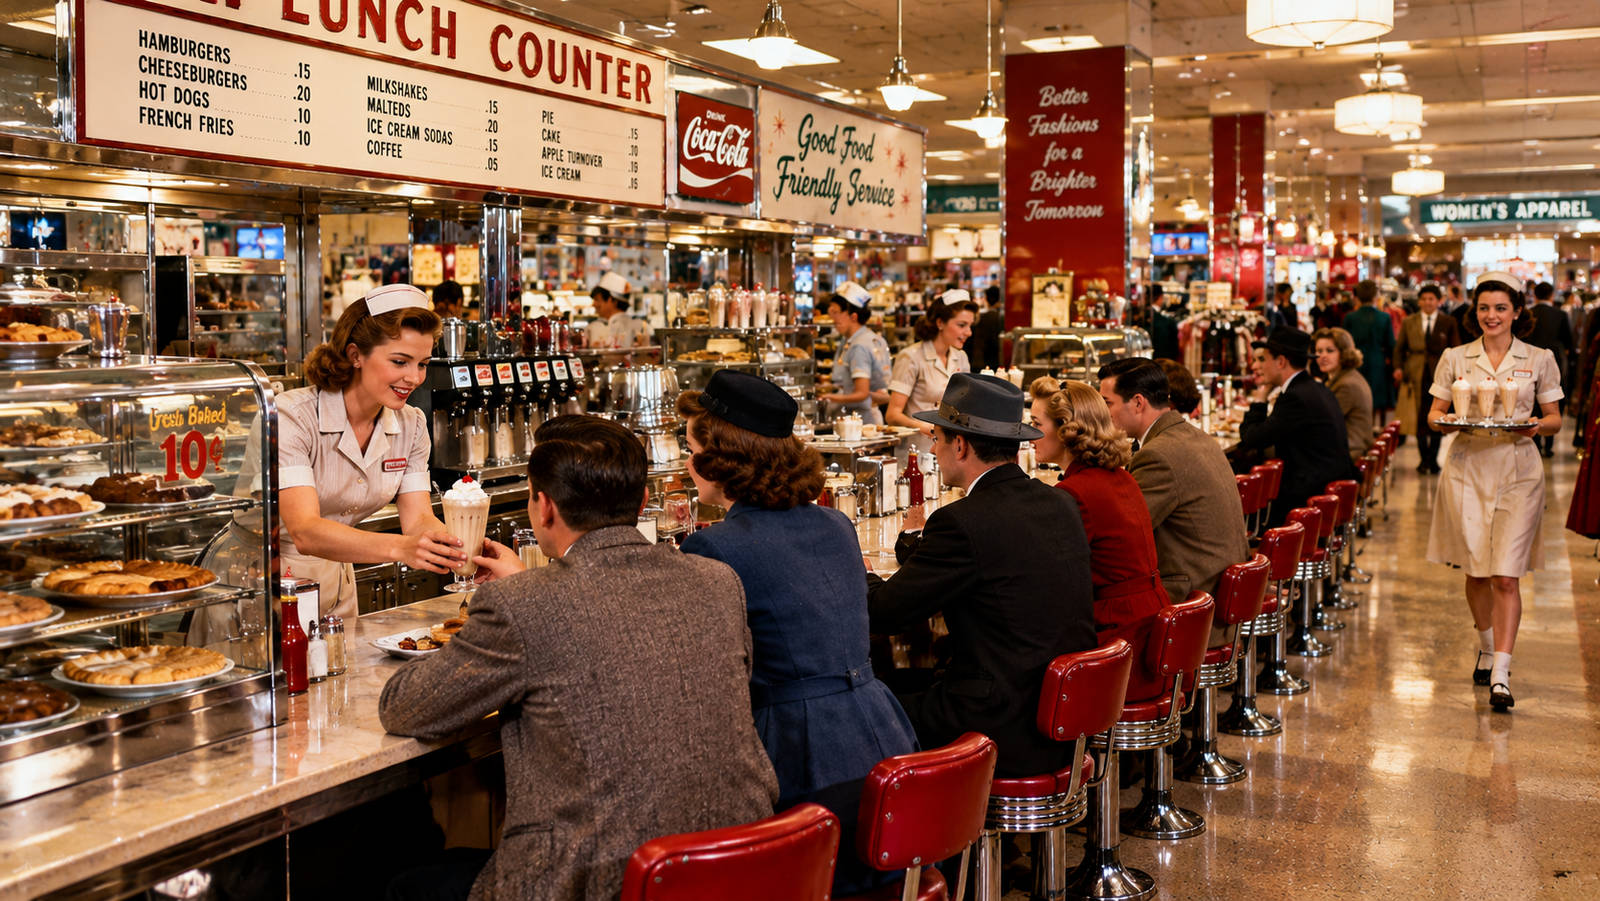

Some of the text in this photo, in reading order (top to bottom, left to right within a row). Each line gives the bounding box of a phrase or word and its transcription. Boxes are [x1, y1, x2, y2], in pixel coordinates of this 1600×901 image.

[139, 29, 311, 80] HAMBURGERS .15
[489, 24, 652, 104] COUNTER
[138, 54, 311, 102] CHEESEBURGERS .20
[367, 75, 498, 115] MILKSHAKES .15
[139, 80, 311, 124] HOT DOGS .10
[1039, 85, 1090, 107] Better
[139, 106, 311, 146] FRENCH FRIES .10
[367, 97, 498, 134] MALTEDS .20
[542, 110, 638, 140] PIE .15
[1028, 113, 1099, 137] Fashions
[367, 118, 498, 153] ICE CREAM SODAS .15
[542, 128, 638, 157] CAKE .10
[683, 116, 751, 168] Coca-Cola
[797, 113, 876, 165] Good Food
[367, 139, 498, 172] COFFEE .05
[542, 147, 564, 162] APPLE
[567, 150, 603, 168] TURNOVER
[1043, 142, 1083, 167] for a
[541, 165, 553, 178] ICE
[556, 167, 581, 182] CREAM
[773, 155, 895, 215] Friendly Service
[1030, 169, 1097, 196] Brighter
[1430, 200, 1593, 221] WOMEN'S APPAREL
